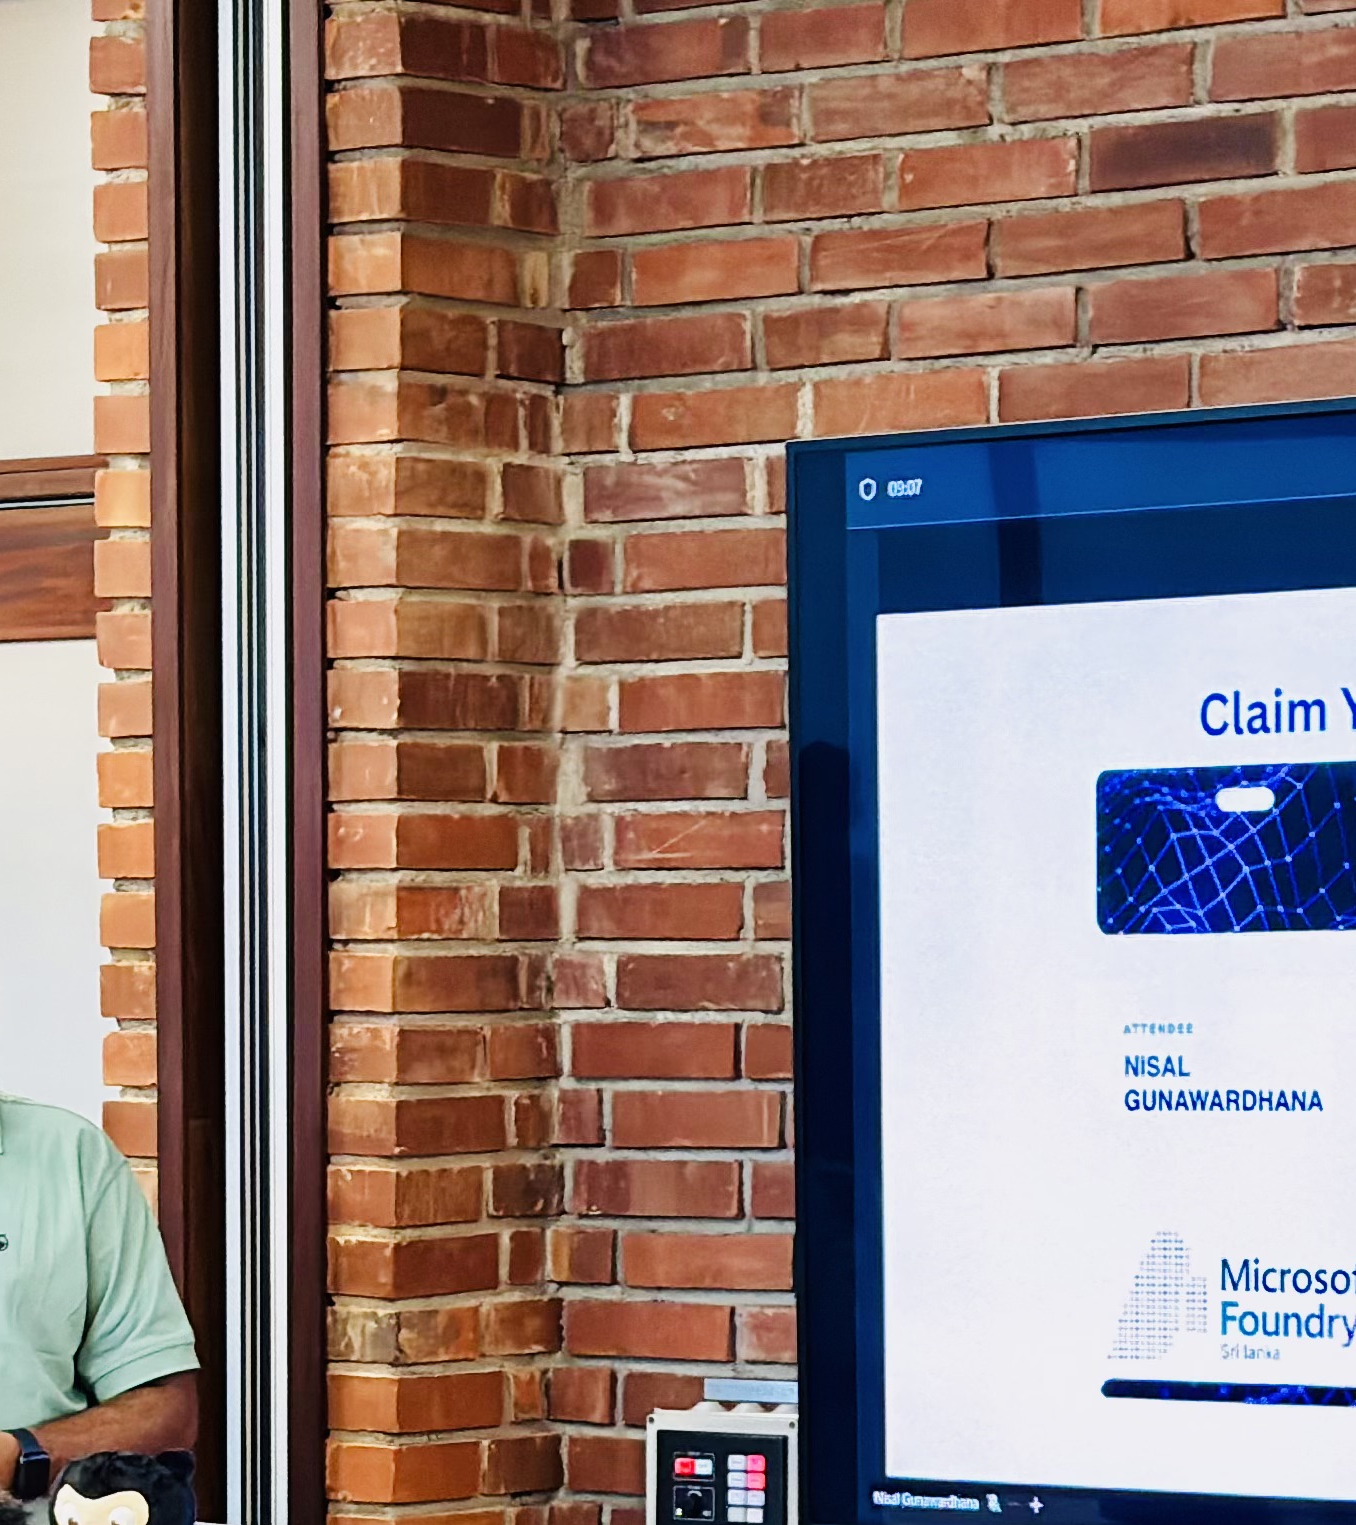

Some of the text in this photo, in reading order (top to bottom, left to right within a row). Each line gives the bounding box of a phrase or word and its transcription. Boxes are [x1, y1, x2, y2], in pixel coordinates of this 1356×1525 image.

[887, 478, 923, 497] 09:07
[1199, 686, 1328, 738] Claim
[1122, 1022, 1195, 1035] ATTENDEE
[1124, 1055, 1191, 1078] NISAL
[1124, 1088, 1324, 1112] GUNAWARDHANA
